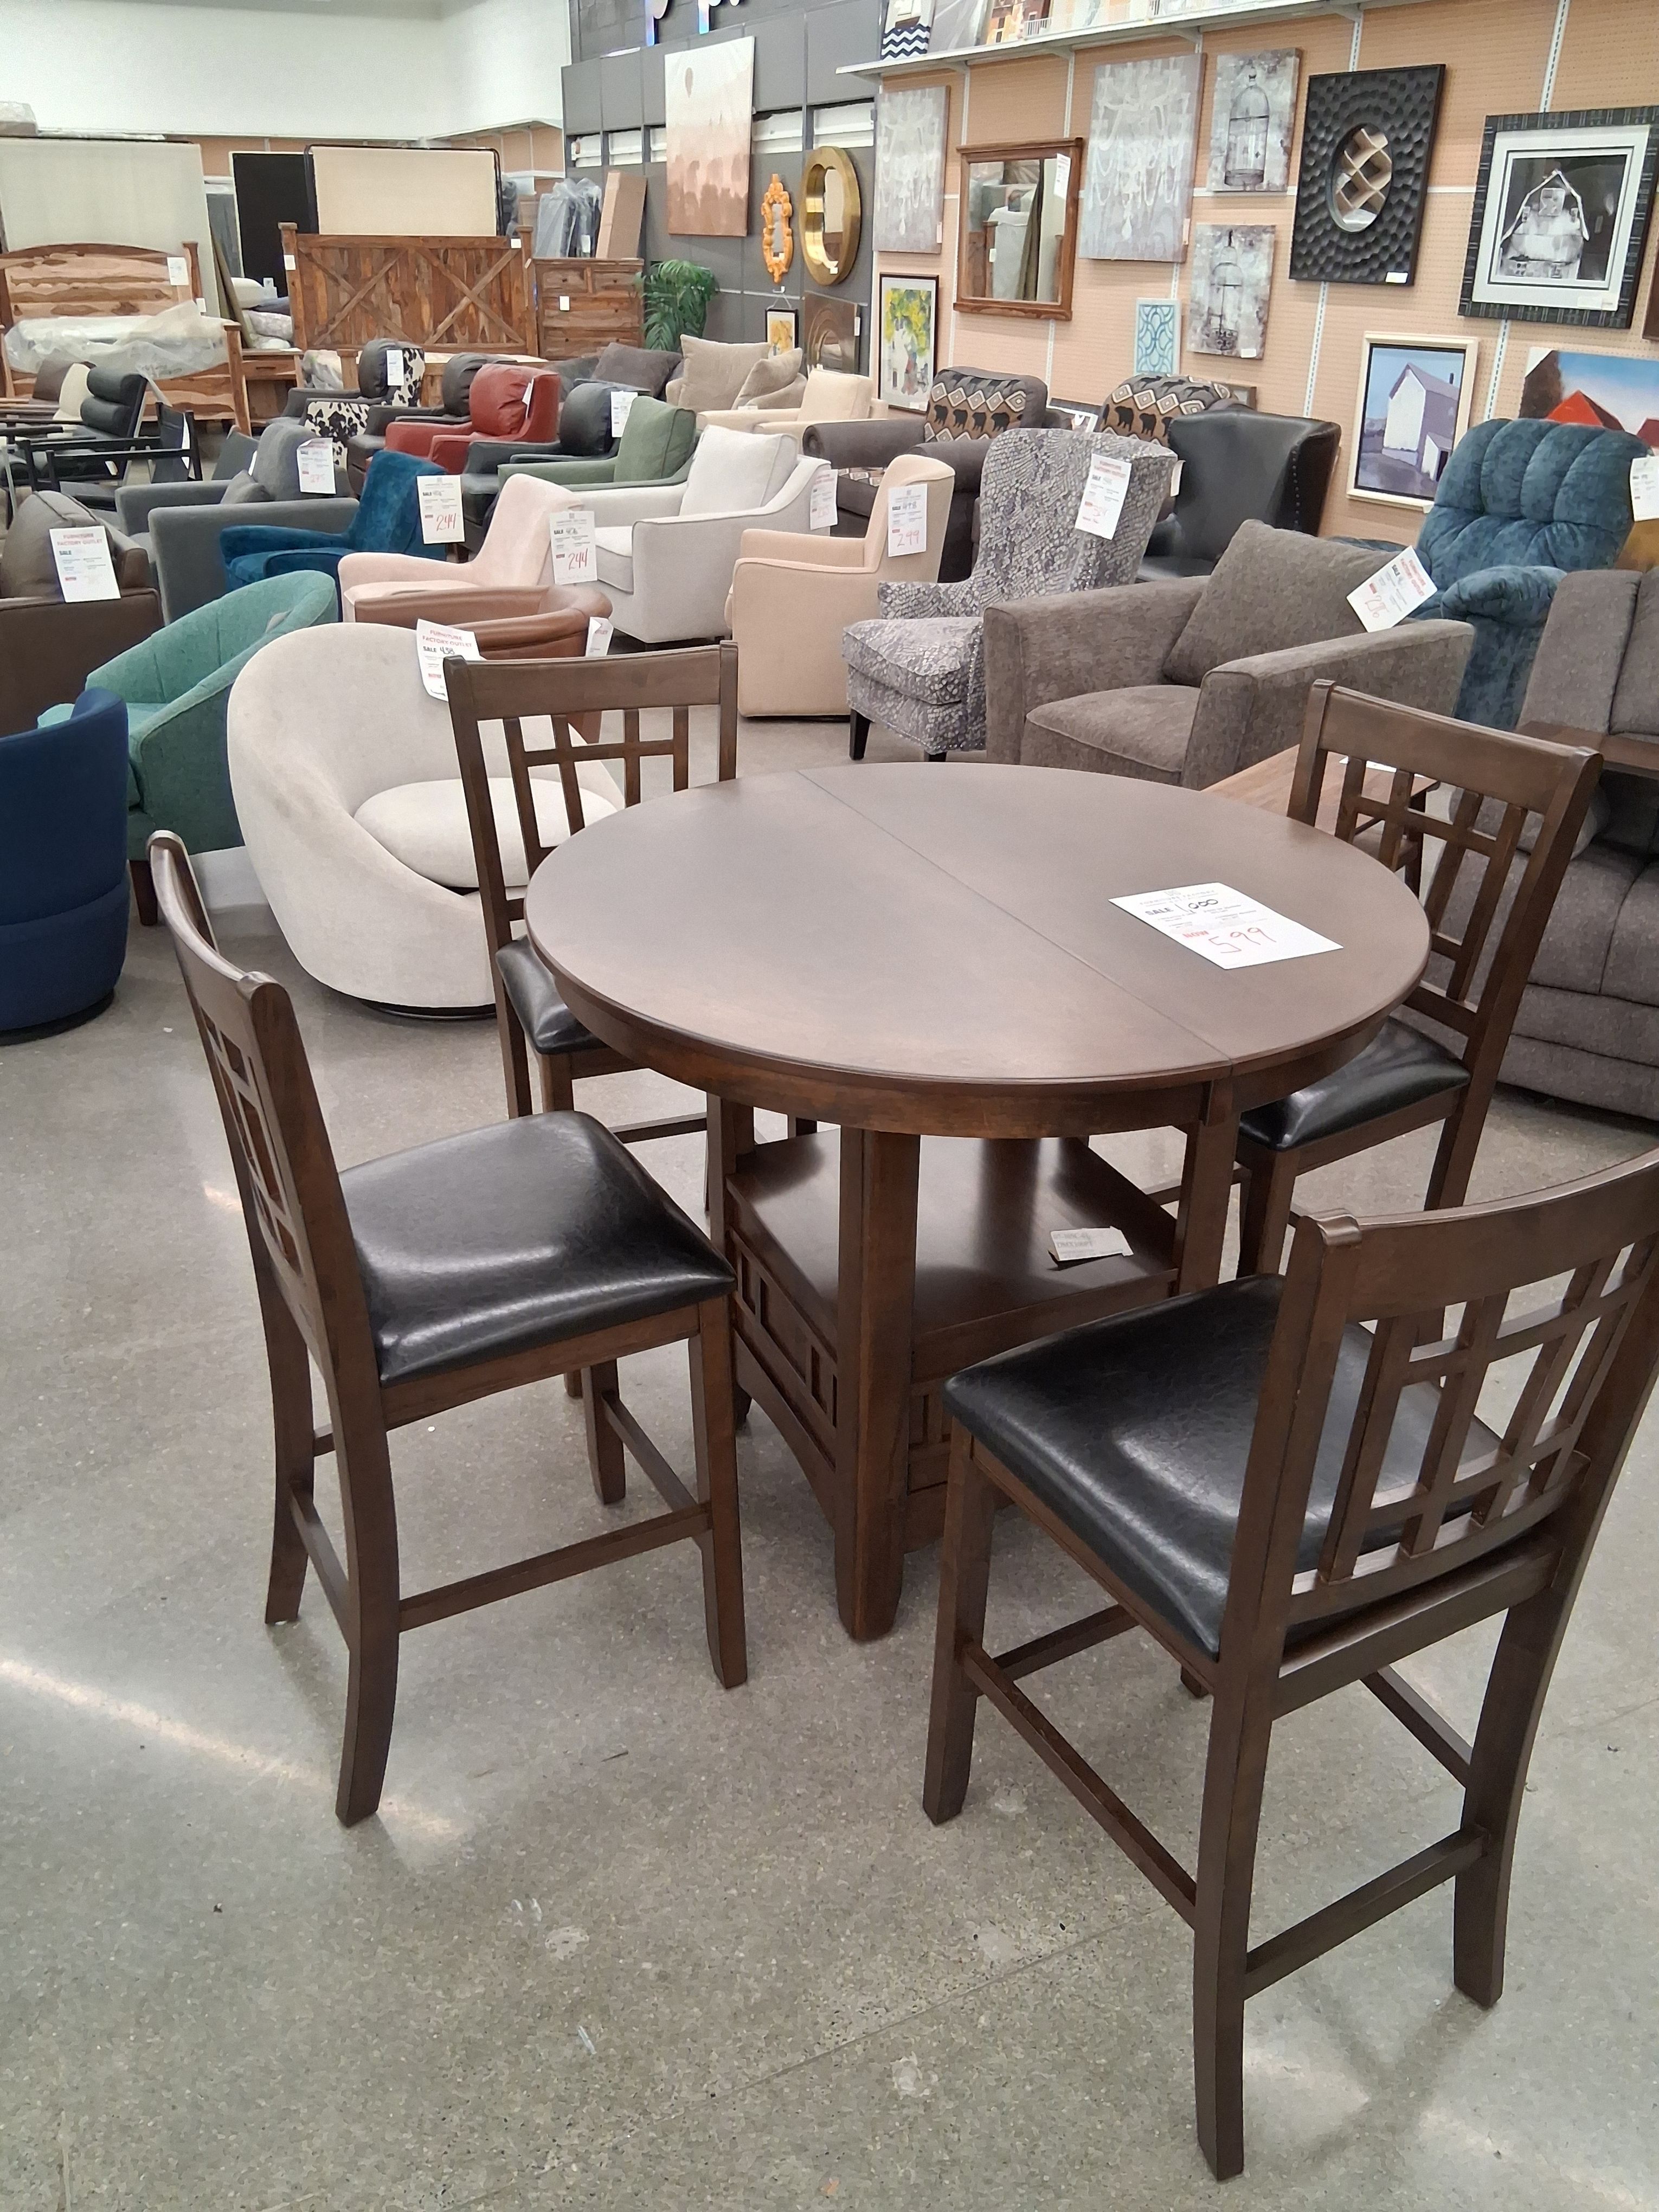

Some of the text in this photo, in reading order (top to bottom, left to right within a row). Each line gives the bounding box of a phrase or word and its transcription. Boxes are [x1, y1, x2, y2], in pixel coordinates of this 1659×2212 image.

[436, 513, 456, 531] 244
[897, 530, 919, 547] 299
[568, 548, 588, 571] 244
[1145, 908, 1174, 916] SALE
[1182, 930, 1210, 938] NOW
[1208, 927, 1277, 953] 599
